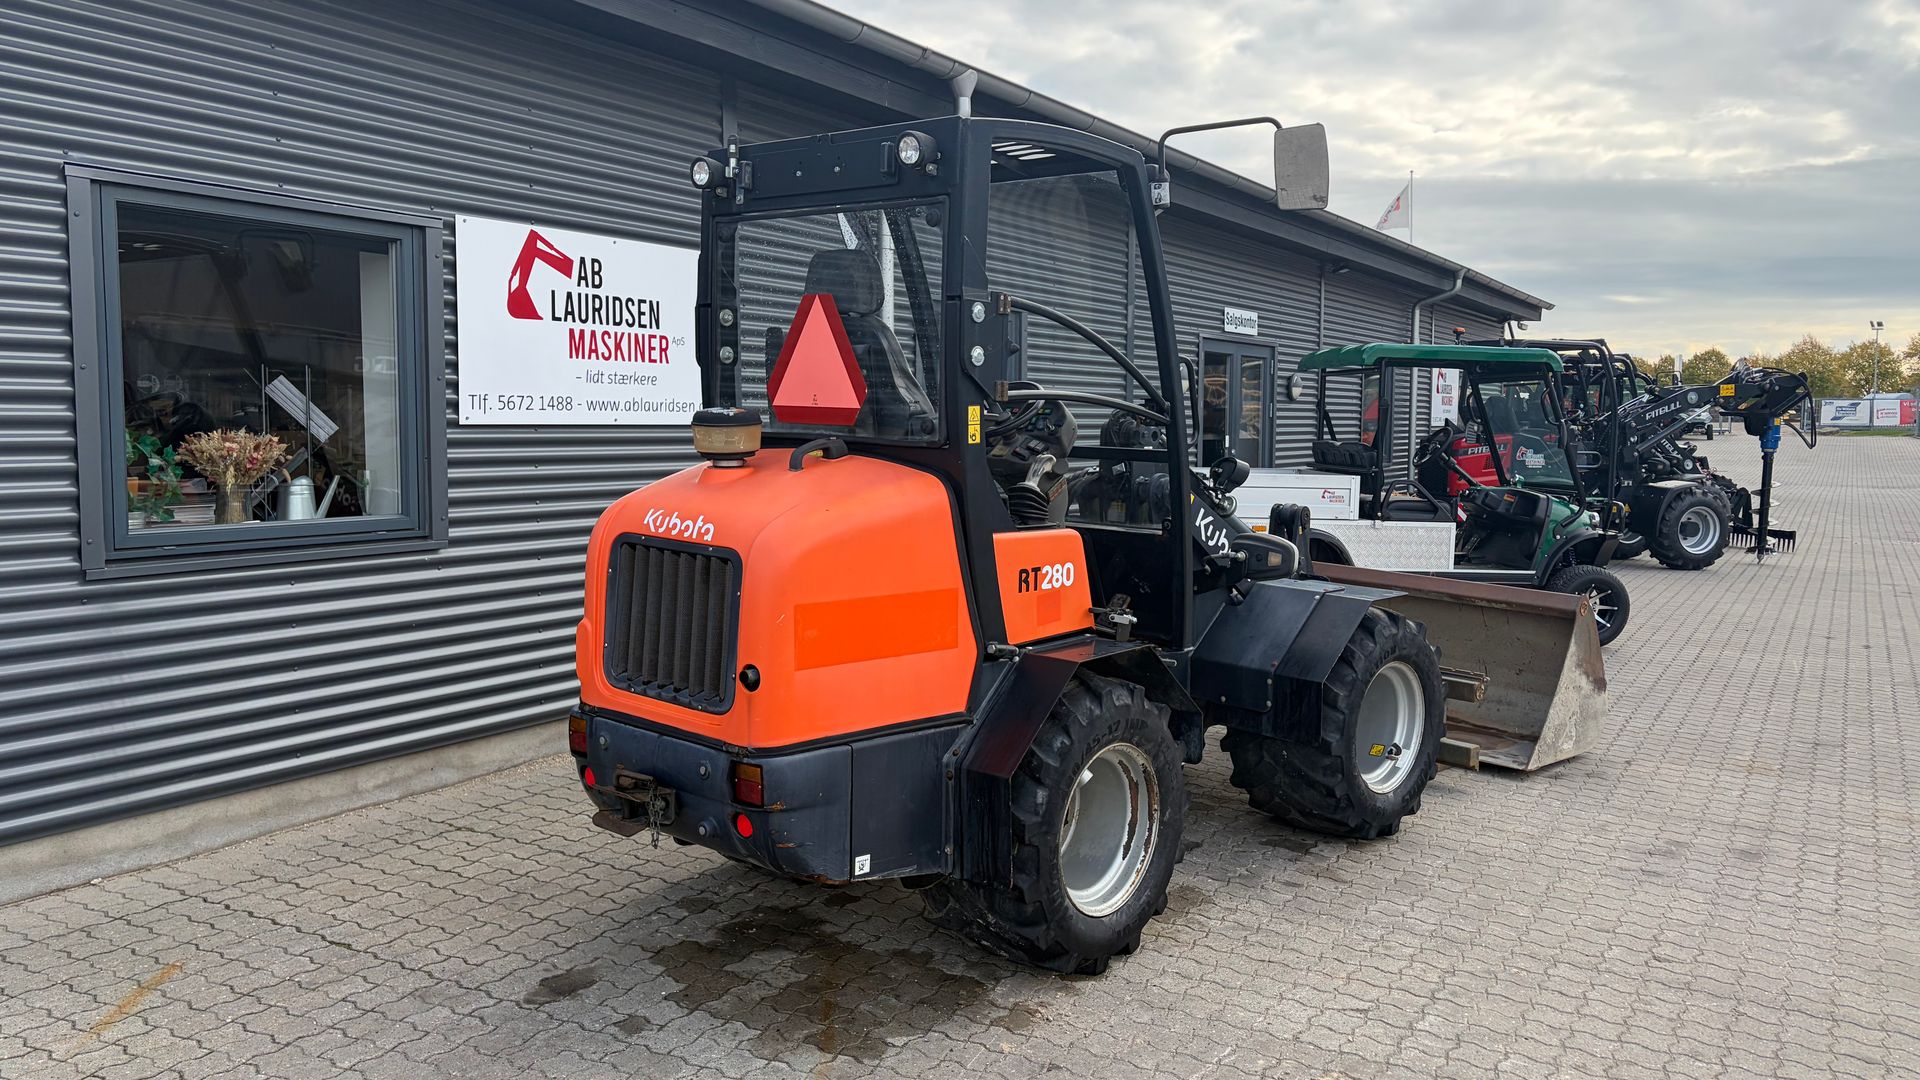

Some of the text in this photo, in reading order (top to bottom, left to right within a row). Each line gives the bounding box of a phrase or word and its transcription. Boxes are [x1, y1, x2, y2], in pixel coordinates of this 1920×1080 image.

[577, 256, 603, 289] AB
[551, 289, 660, 330] LAURIDSEN
[1225, 311, 1257, 330] Salgskontor
[568, 327, 686, 364] MASKINER ApS
[585, 369, 604, 384] lidt
[607, 371, 658, 386] stærkere
[468, 393, 493, 415] Tlf.
[498, 394, 534, 411] 5672
[538, 395, 574, 412] 1488
[585, 397, 703, 413] www.ablauridsen
[1645, 401, 1682, 420] PITBULL
[643, 508, 715, 542] Kubota
[1195, 507, 1231, 555] Kub
[1018, 562, 1075, 594] RT280
